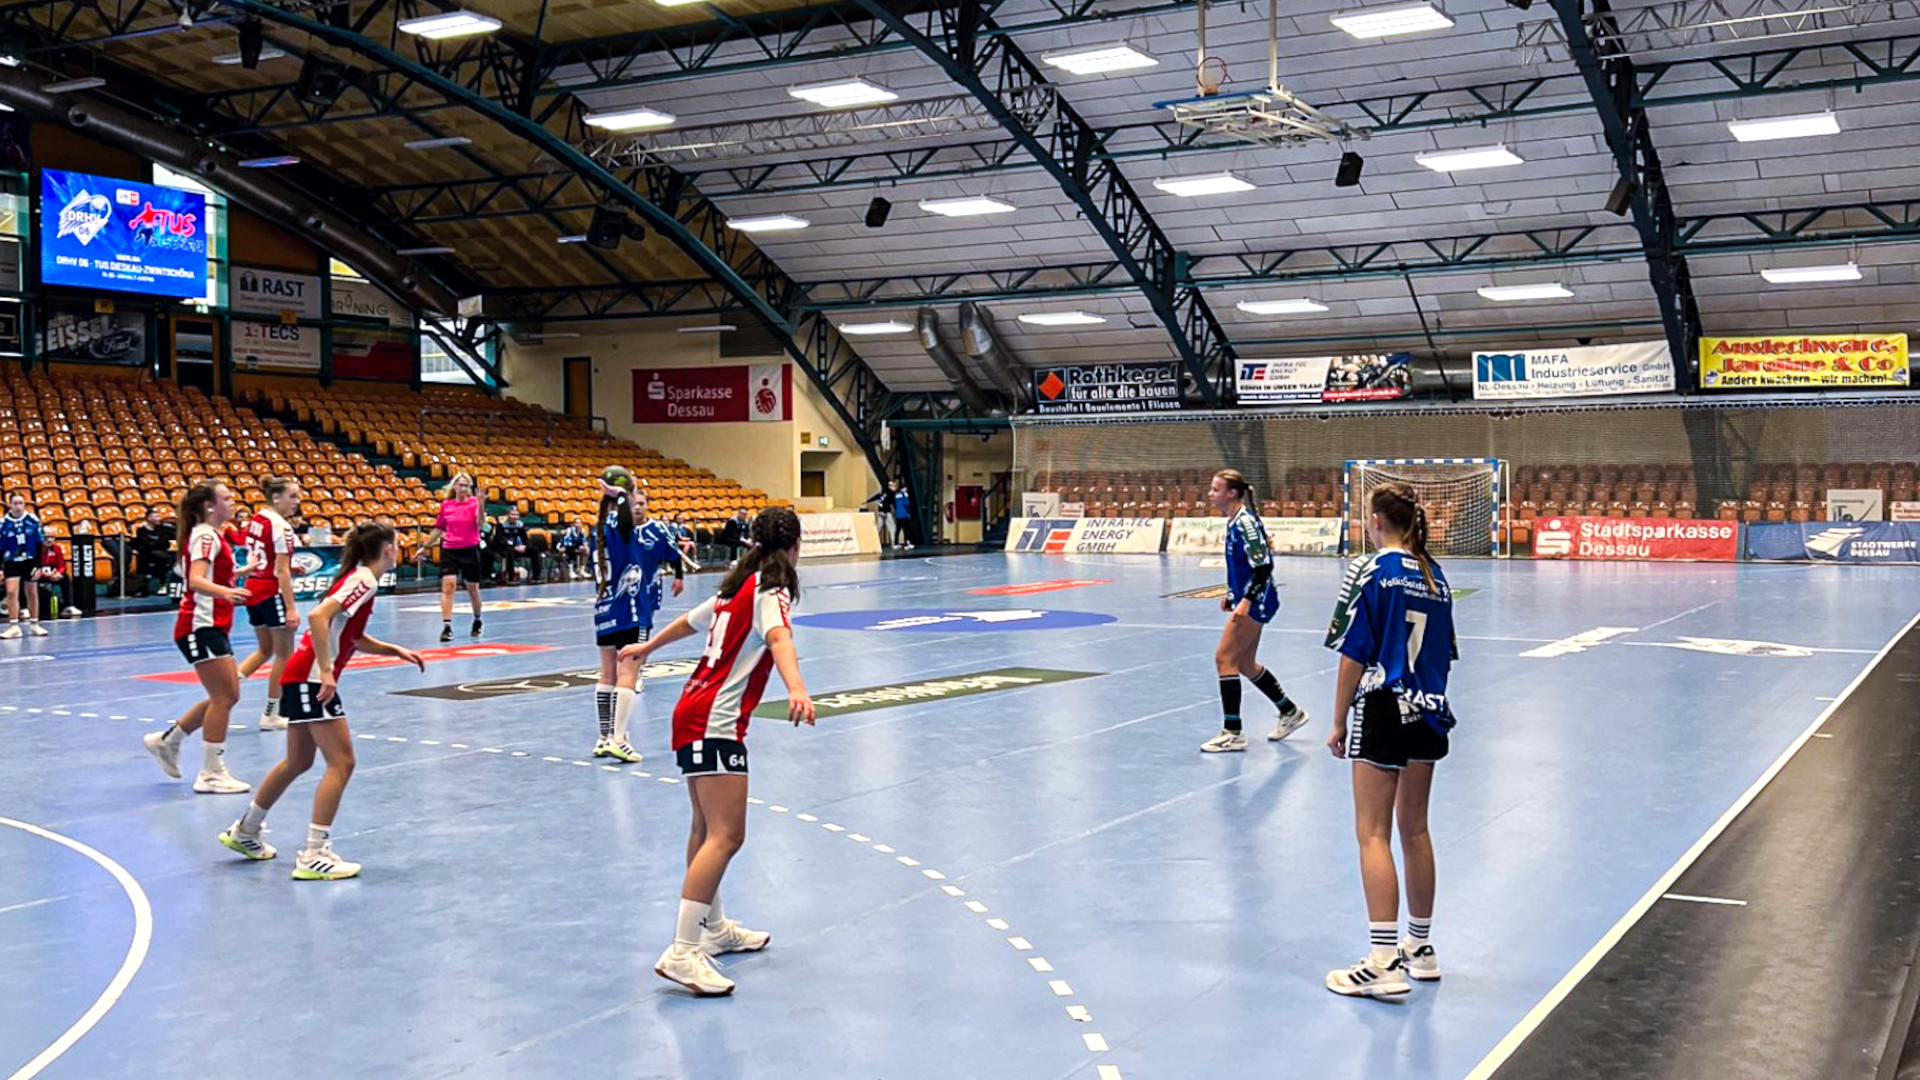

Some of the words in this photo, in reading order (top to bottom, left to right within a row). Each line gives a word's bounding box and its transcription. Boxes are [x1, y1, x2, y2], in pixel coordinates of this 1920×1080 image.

[68, 210, 101, 222] DRHV
[56, 255, 78, 266] DRHV
[262, 278, 305, 298] RAST
[1531, 355, 1569, 365] MAFA
[1832, 357, 1852, 372] &
[1859, 356, 1895, 372] Co
[1069, 364, 1178, 387] Rothkegel
[1531, 365, 1638, 379] Industrieservice
[1643, 362, 1671, 372] GmbH
[1537, 381, 1576, 392] Heizung
[1585, 378, 1624, 390] Lüftung
[1633, 373, 1670, 384] Sanitär
[1721, 375, 1757, 386] Andere
[1821, 374, 1838, 385] wir
[667, 385, 733, 402] Sparkasse
[1071, 387, 1088, 400] für
[1090, 386, 1113, 399] alle
[1117, 384, 1136, 398] die
[1139, 382, 1176, 397] bauen
[667, 402, 715, 417] Dessau
[1081, 530, 1134, 540] ENERGY
[1580, 522, 1732, 541] Stadtsparkasse
[1578, 541, 1650, 557] Dessau
[1850, 540, 1917, 550] STADTWERKE
[83, 544, 93, 577] SELECT
[1850, 549, 1890, 558] DESSAU
[1405, 610, 1428, 674] 7
[729, 754, 745, 767] 64
